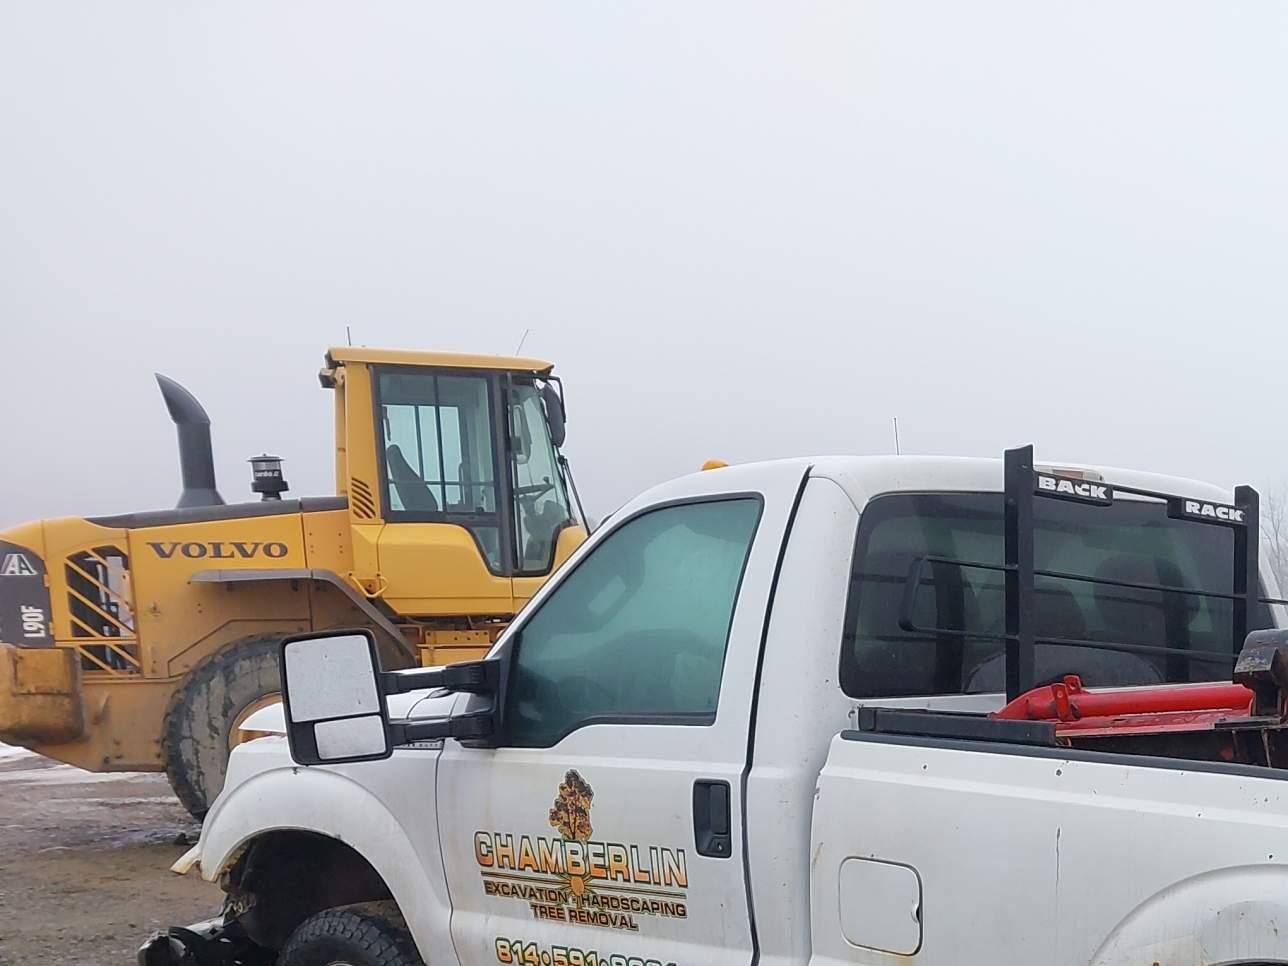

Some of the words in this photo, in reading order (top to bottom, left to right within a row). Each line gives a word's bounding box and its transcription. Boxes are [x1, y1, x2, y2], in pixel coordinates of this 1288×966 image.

[1037, 475, 1108, 500] BACK
[1185, 500, 1246, 522] RACK
[146, 541, 289, 559] VOLVO
[20, 604, 46, 638] L90F
[473, 831, 689, 889] CHAMBERLIN
[484, 880, 568, 904] EXCAVATION
[581, 893, 687, 918] HARDSCAPING
[531, 904, 565, 921] TREE
[568, 909, 638, 931] REMOVAL
